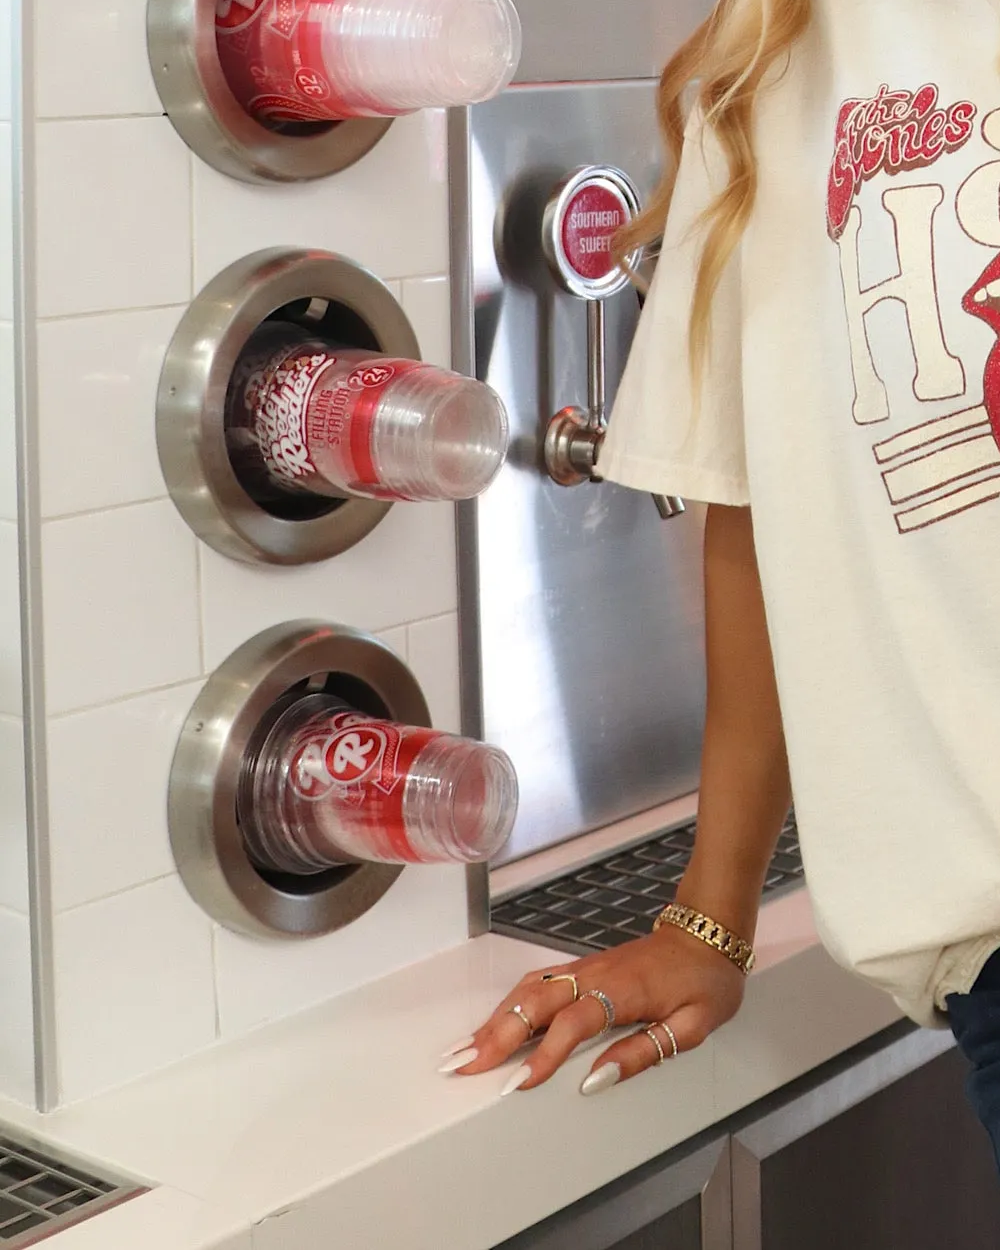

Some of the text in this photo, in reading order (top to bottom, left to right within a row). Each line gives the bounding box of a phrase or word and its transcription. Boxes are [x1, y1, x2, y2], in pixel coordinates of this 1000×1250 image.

[298, 73, 323, 96] 32
[570, 209, 621, 229] SOUTHERN
[363, 367, 388, 384] 24
[311, 389, 334, 442] FILLING
[327, 387, 351, 446] STATION
